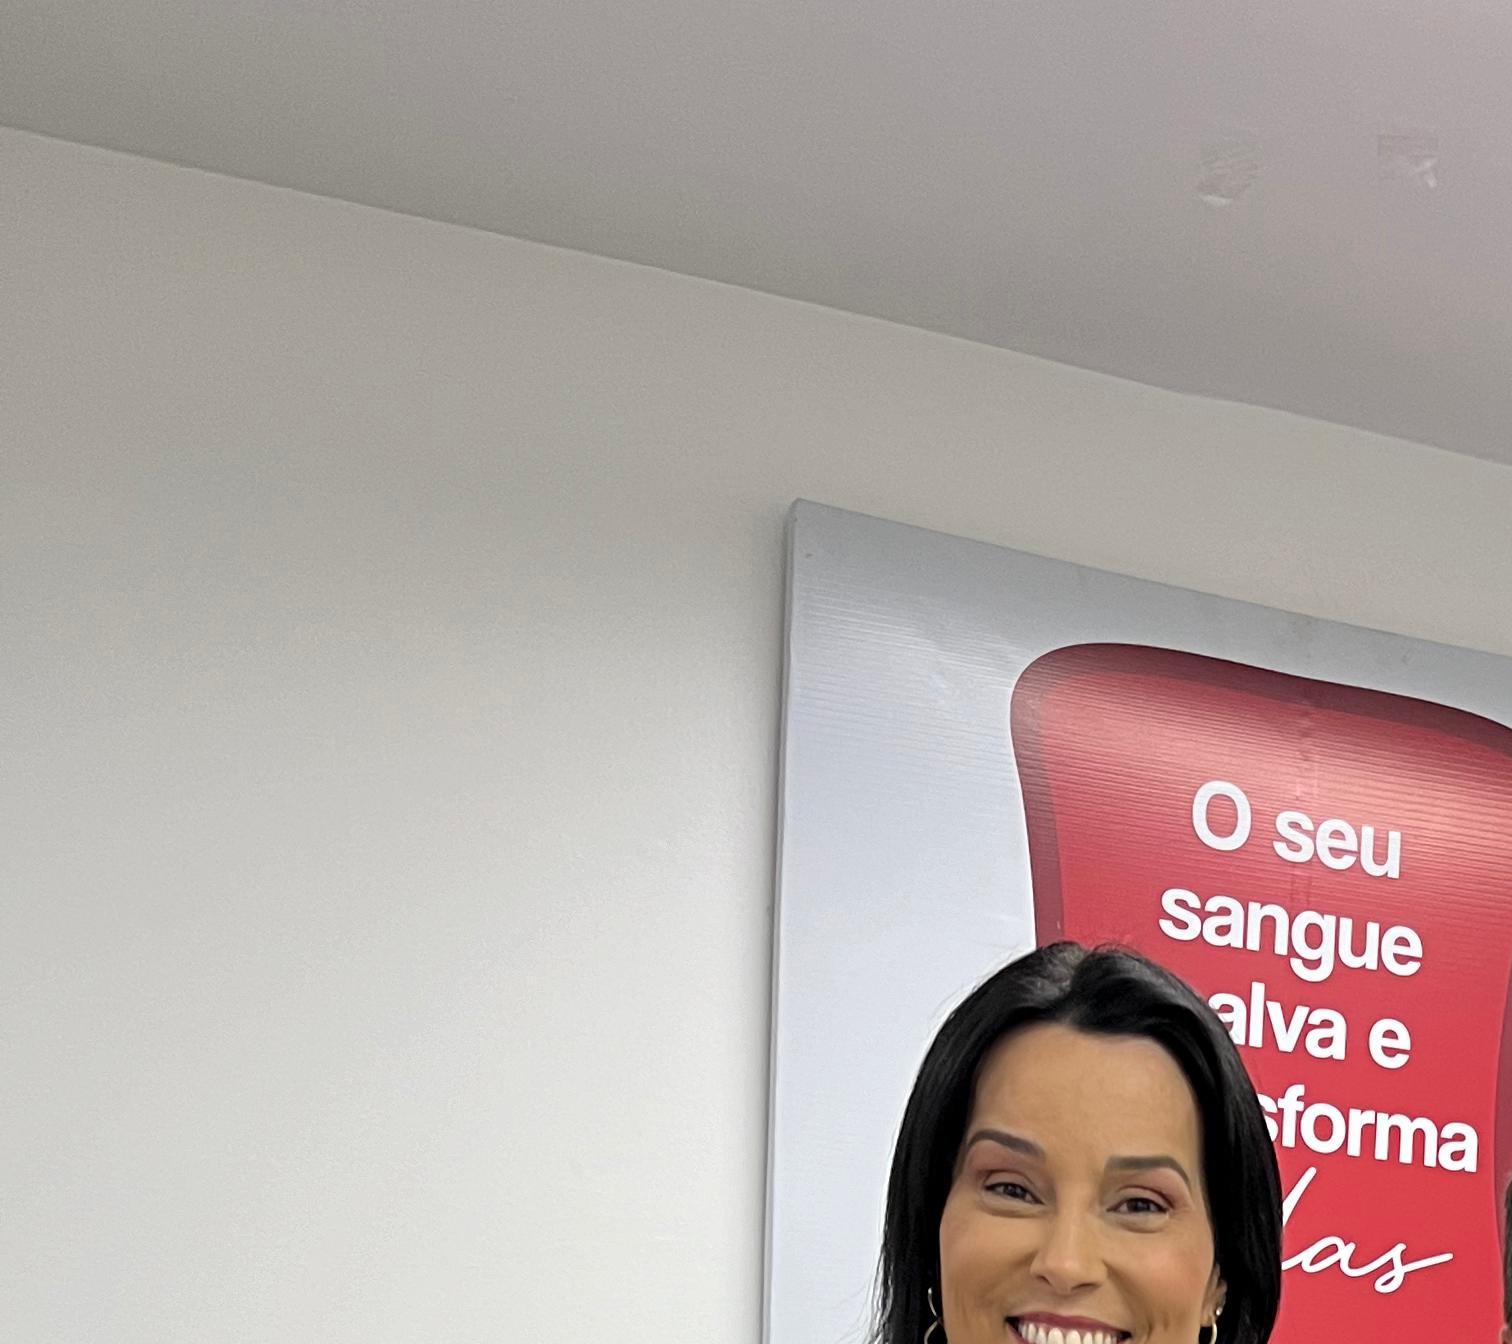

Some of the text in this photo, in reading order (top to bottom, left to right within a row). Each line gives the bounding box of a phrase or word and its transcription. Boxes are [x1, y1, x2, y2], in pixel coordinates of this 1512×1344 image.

[1191, 780, 1402, 879] O seu
[1158, 887, 1423, 983] sangue
[1208, 981, 1412, 1070] alva e
